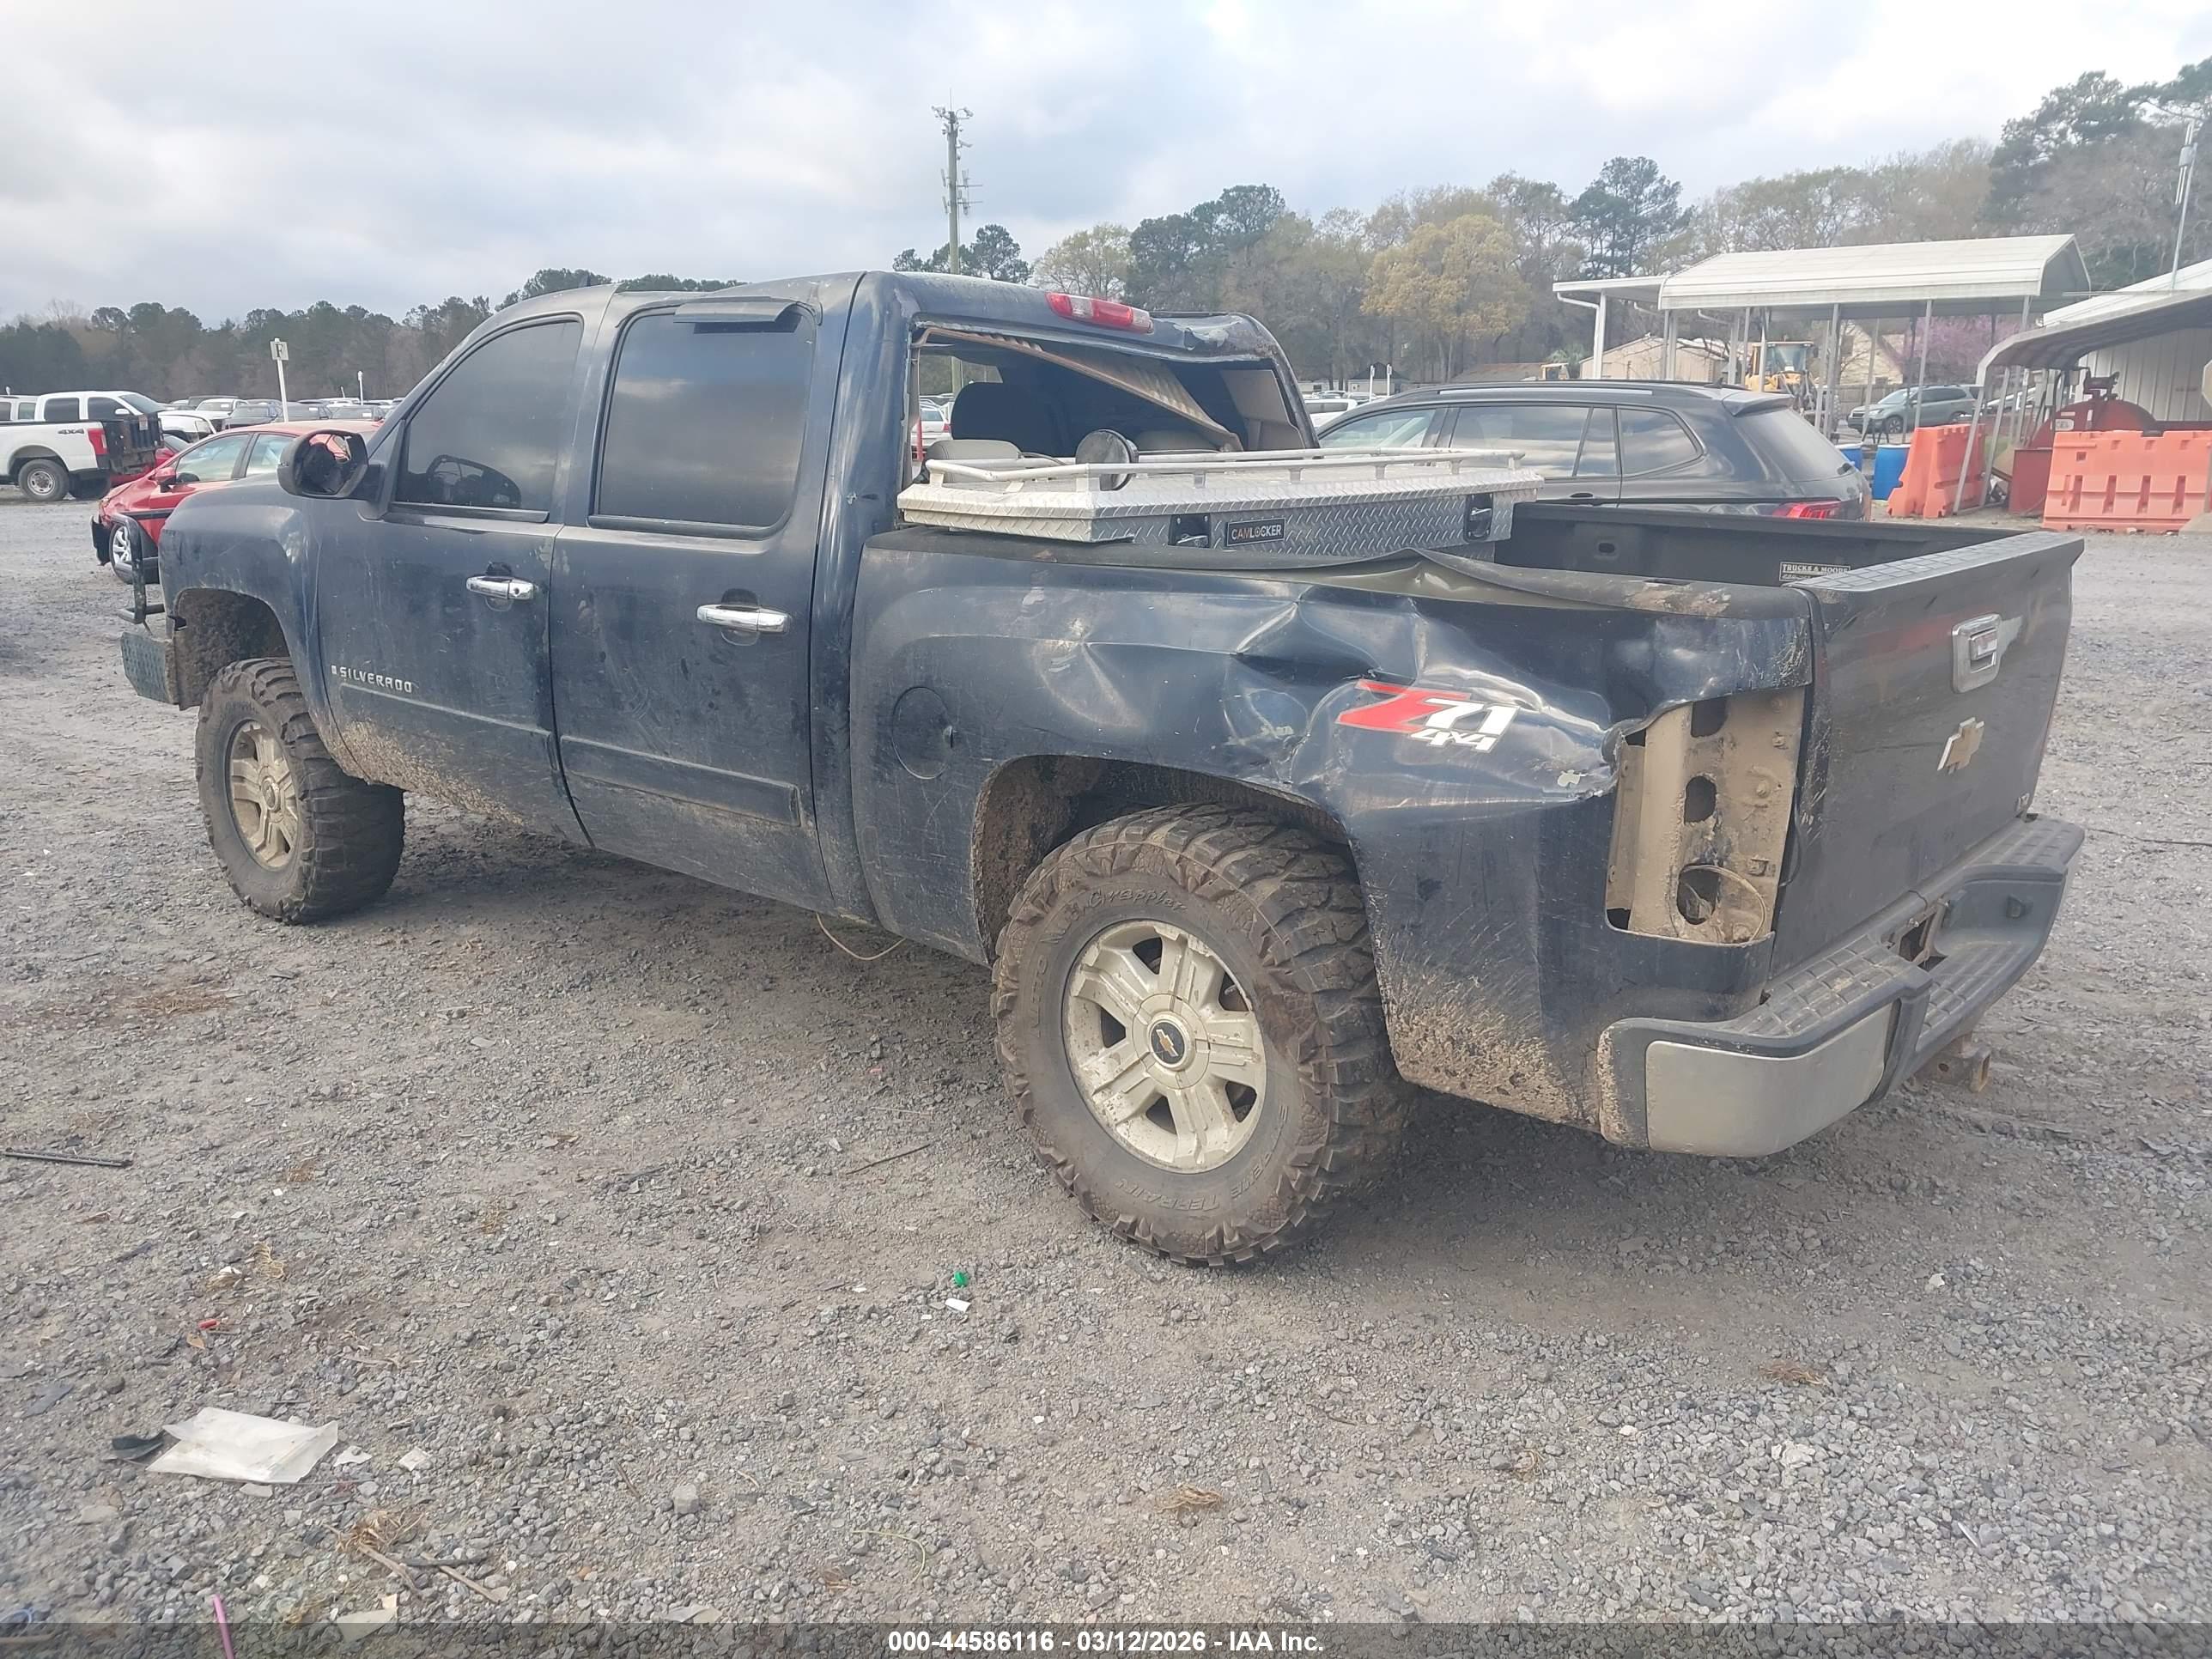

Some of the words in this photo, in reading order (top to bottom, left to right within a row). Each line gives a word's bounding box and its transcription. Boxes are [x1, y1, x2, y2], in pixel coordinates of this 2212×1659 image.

[275, 343, 283, 358] F
[1231, 525, 1282, 540] CAMLOCKER
[1782, 563, 1813, 573] TRUCKS
[340, 666, 412, 693] SILVERADO
[1335, 679, 1519, 736] Z71
[1087, 888, 1188, 912] Grappler
